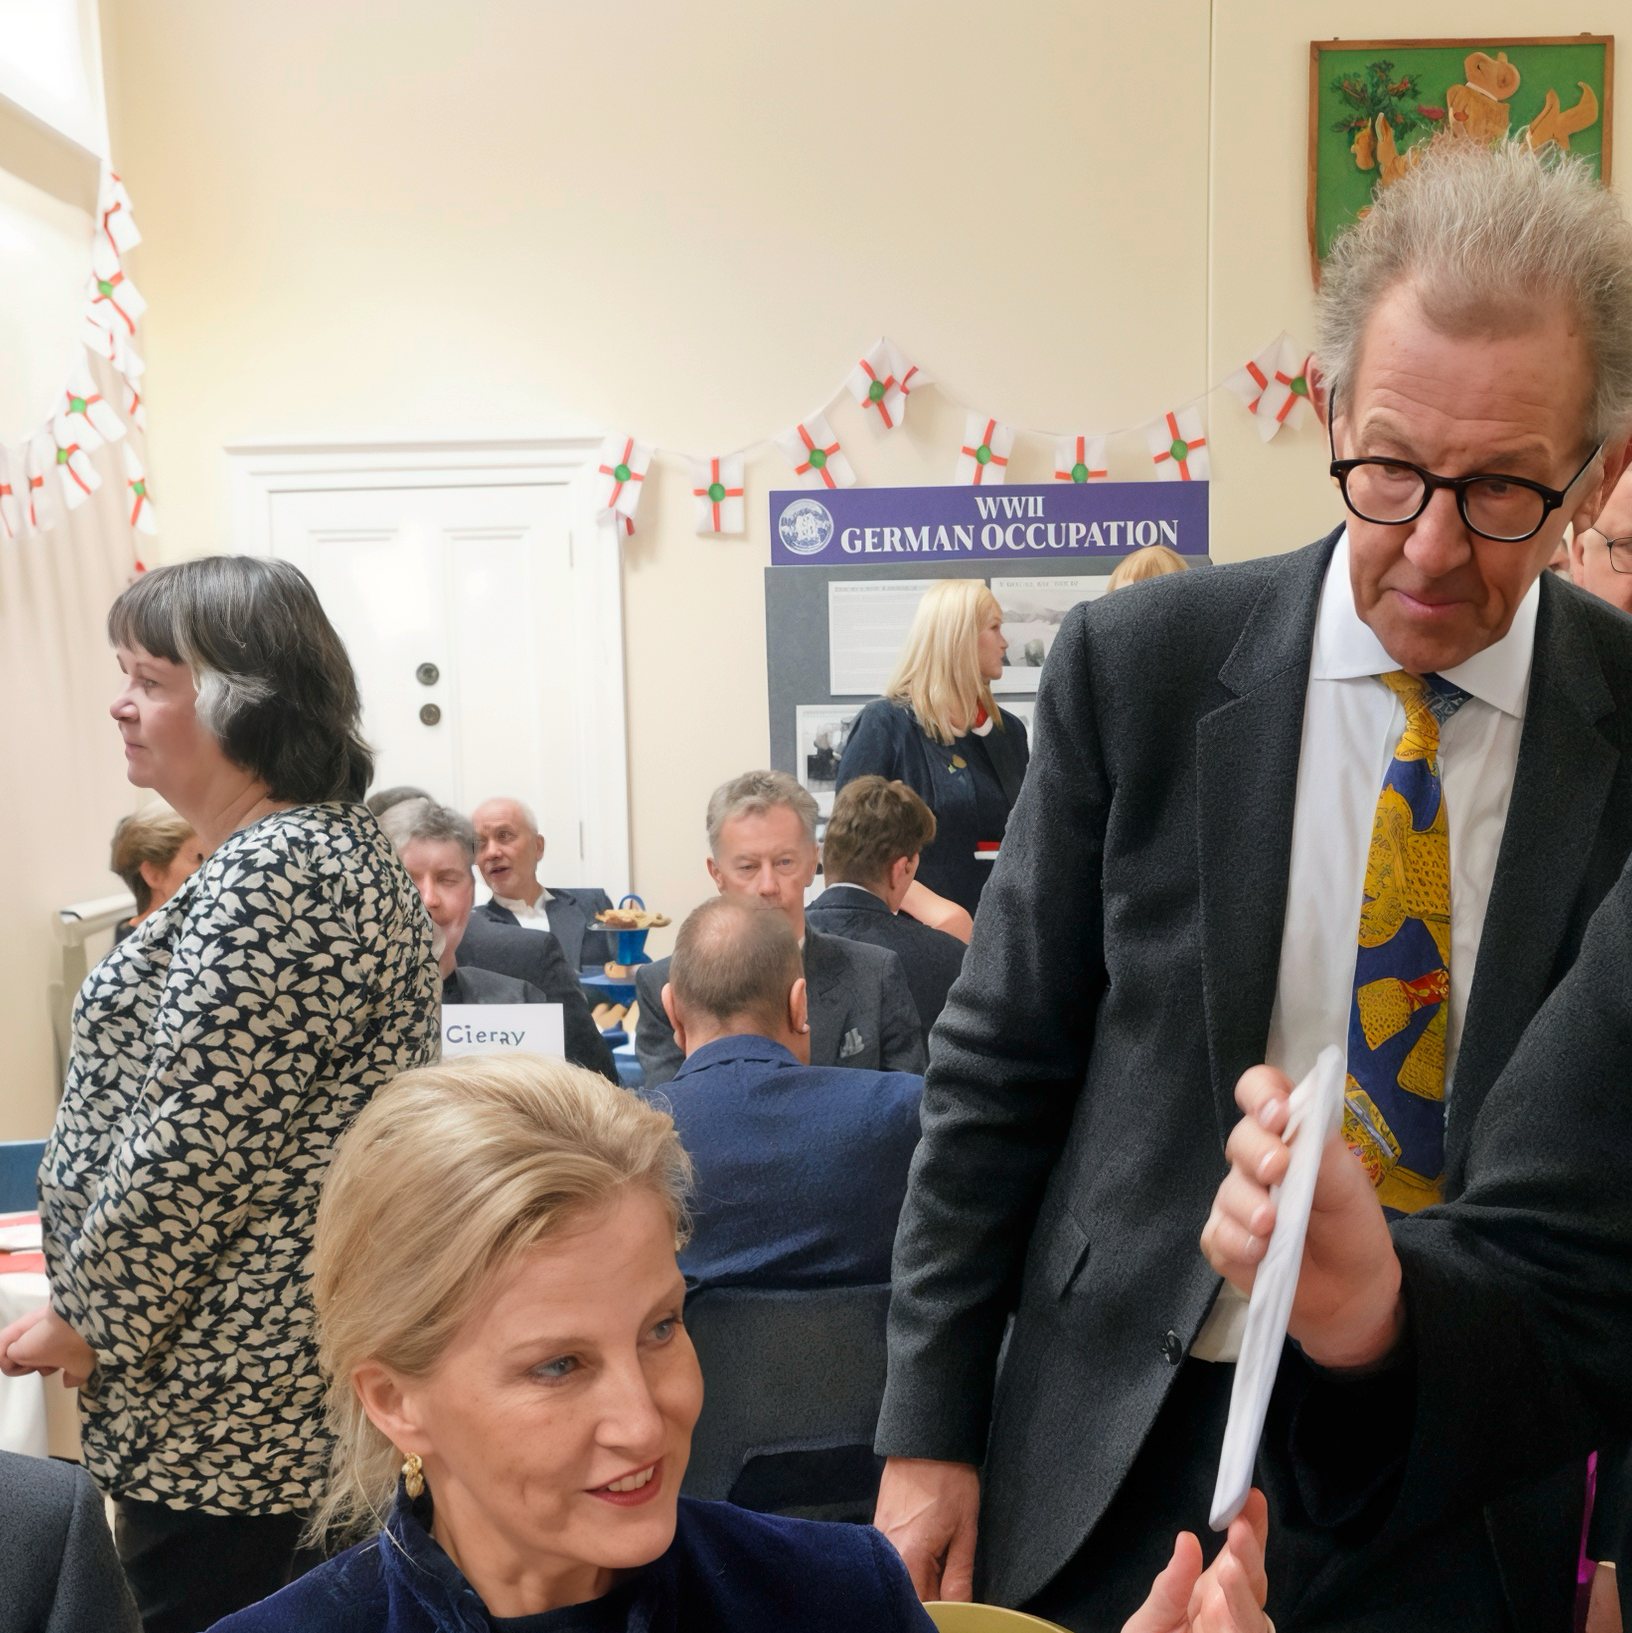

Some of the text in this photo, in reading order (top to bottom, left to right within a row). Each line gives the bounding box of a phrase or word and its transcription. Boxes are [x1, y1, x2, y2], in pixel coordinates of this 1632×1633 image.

[974, 496, 1046, 519] WWII
[840, 520, 1179, 553] GERMAN OCCUPATION
